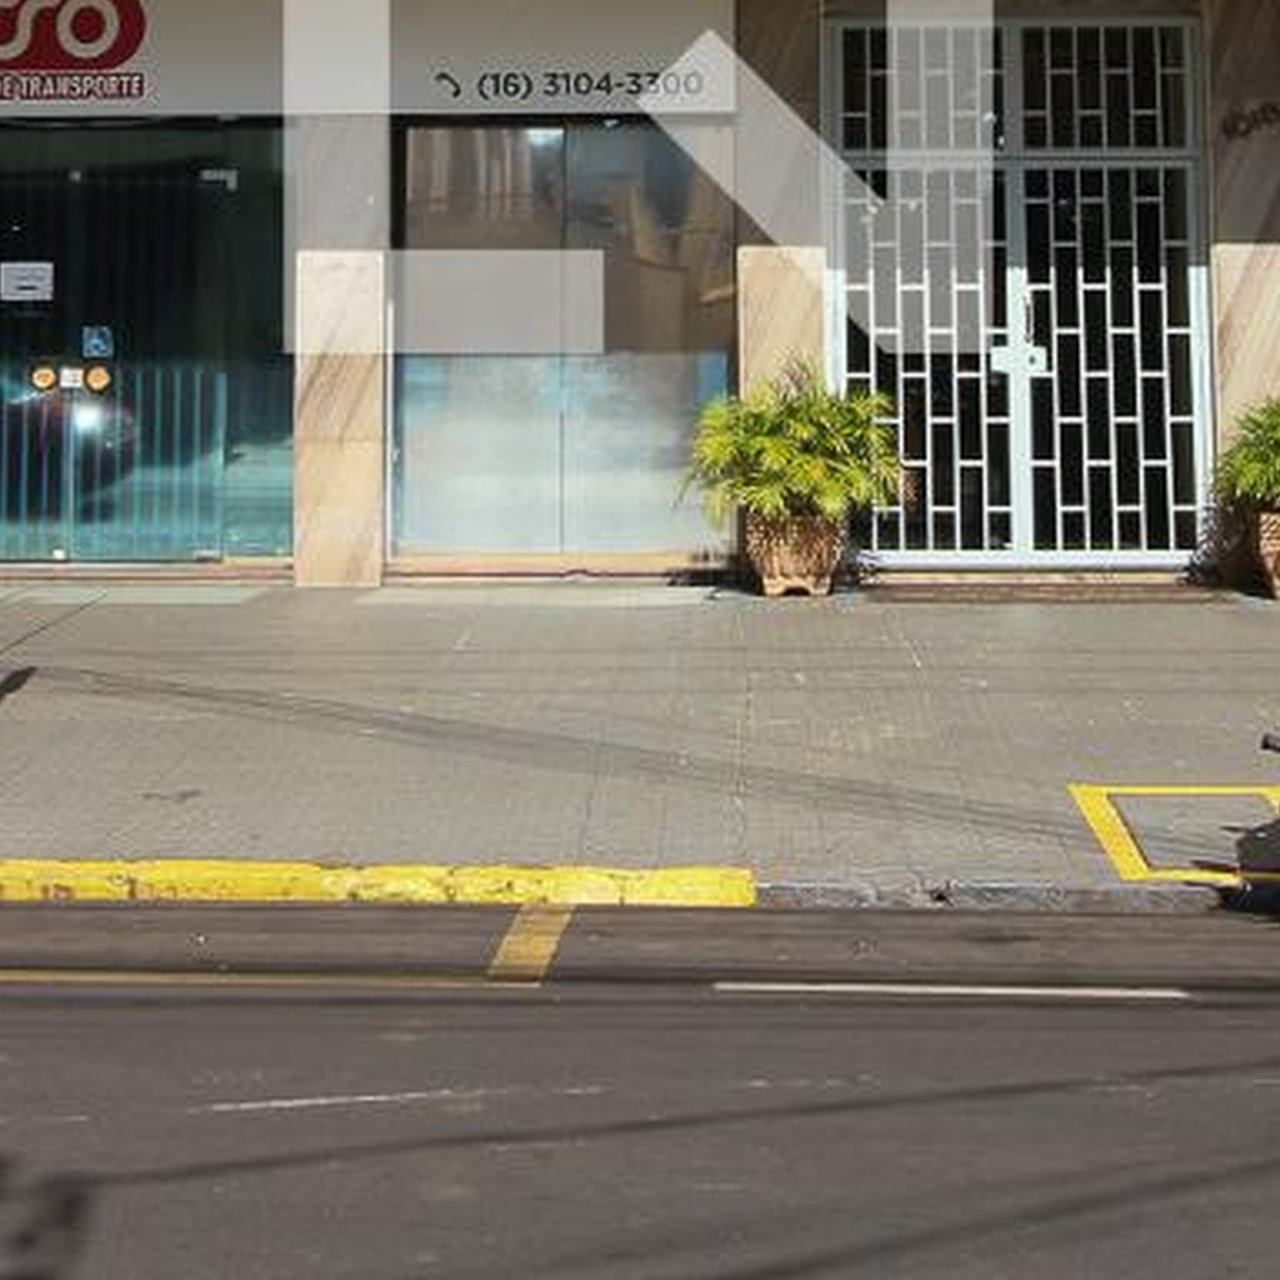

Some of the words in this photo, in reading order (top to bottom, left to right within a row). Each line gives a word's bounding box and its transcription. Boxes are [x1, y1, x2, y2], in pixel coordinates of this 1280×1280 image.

[19, 74, 142, 98] TRANSPORTE
[477, 72, 534, 101] (16)
[542, 72, 704, 97] 3104-3300
